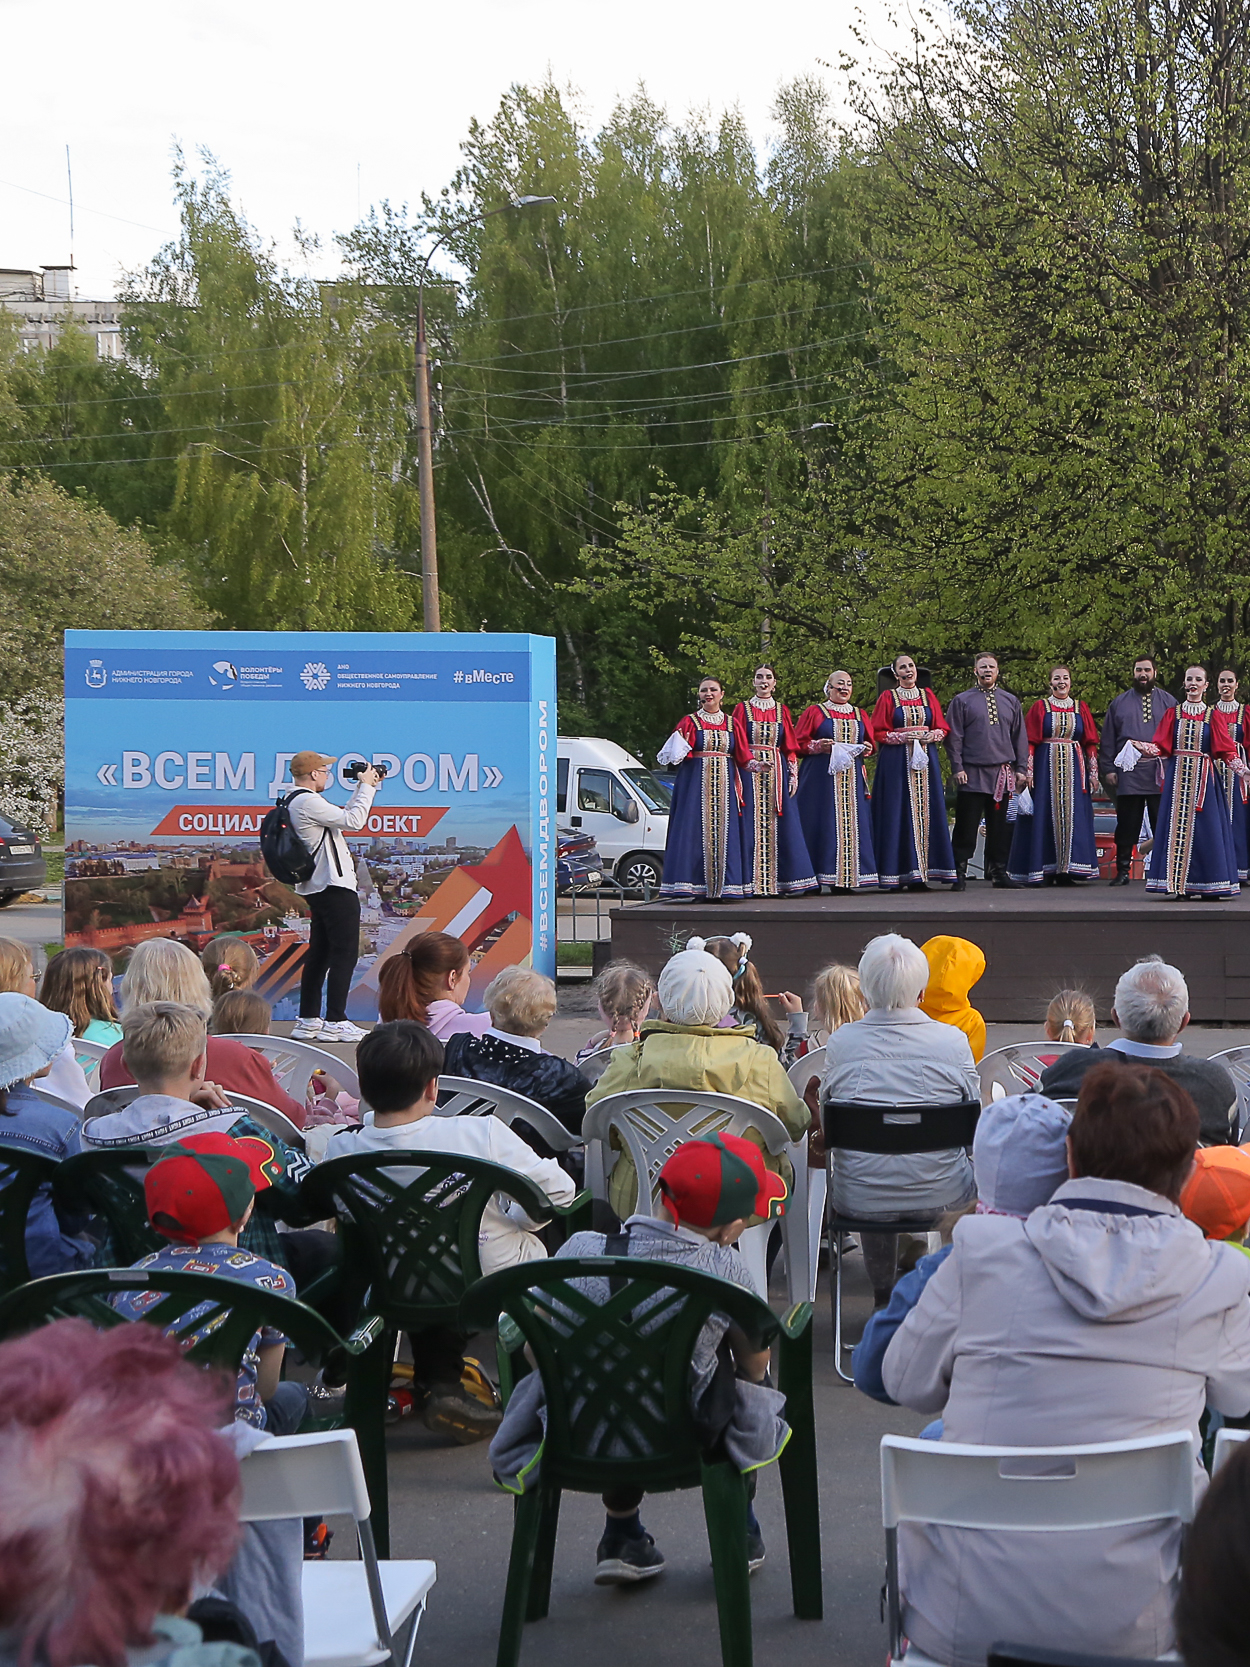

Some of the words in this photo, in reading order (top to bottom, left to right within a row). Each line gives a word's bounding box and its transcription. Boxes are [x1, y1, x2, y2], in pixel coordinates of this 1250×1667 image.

[111, 670, 168, 678] АДМИНИСТРАЦИЯ
[168, 670, 194, 678] ГОРОДА
[240, 666, 283, 674] ВОЛОНТЁРЫ
[144, 677, 182, 685] НОВГОРОДА
[240, 673, 270, 681] ПОБЕДЫ
[453, 669, 515, 685] #вМесте
[96, 750, 256, 790] «ВСЕМ
[179, 813, 267, 834] СОЦИАЛ
[367, 815, 422, 833] ОЕКТ
[538, 700, 550, 952] #ВСЕМДВОРОМ
